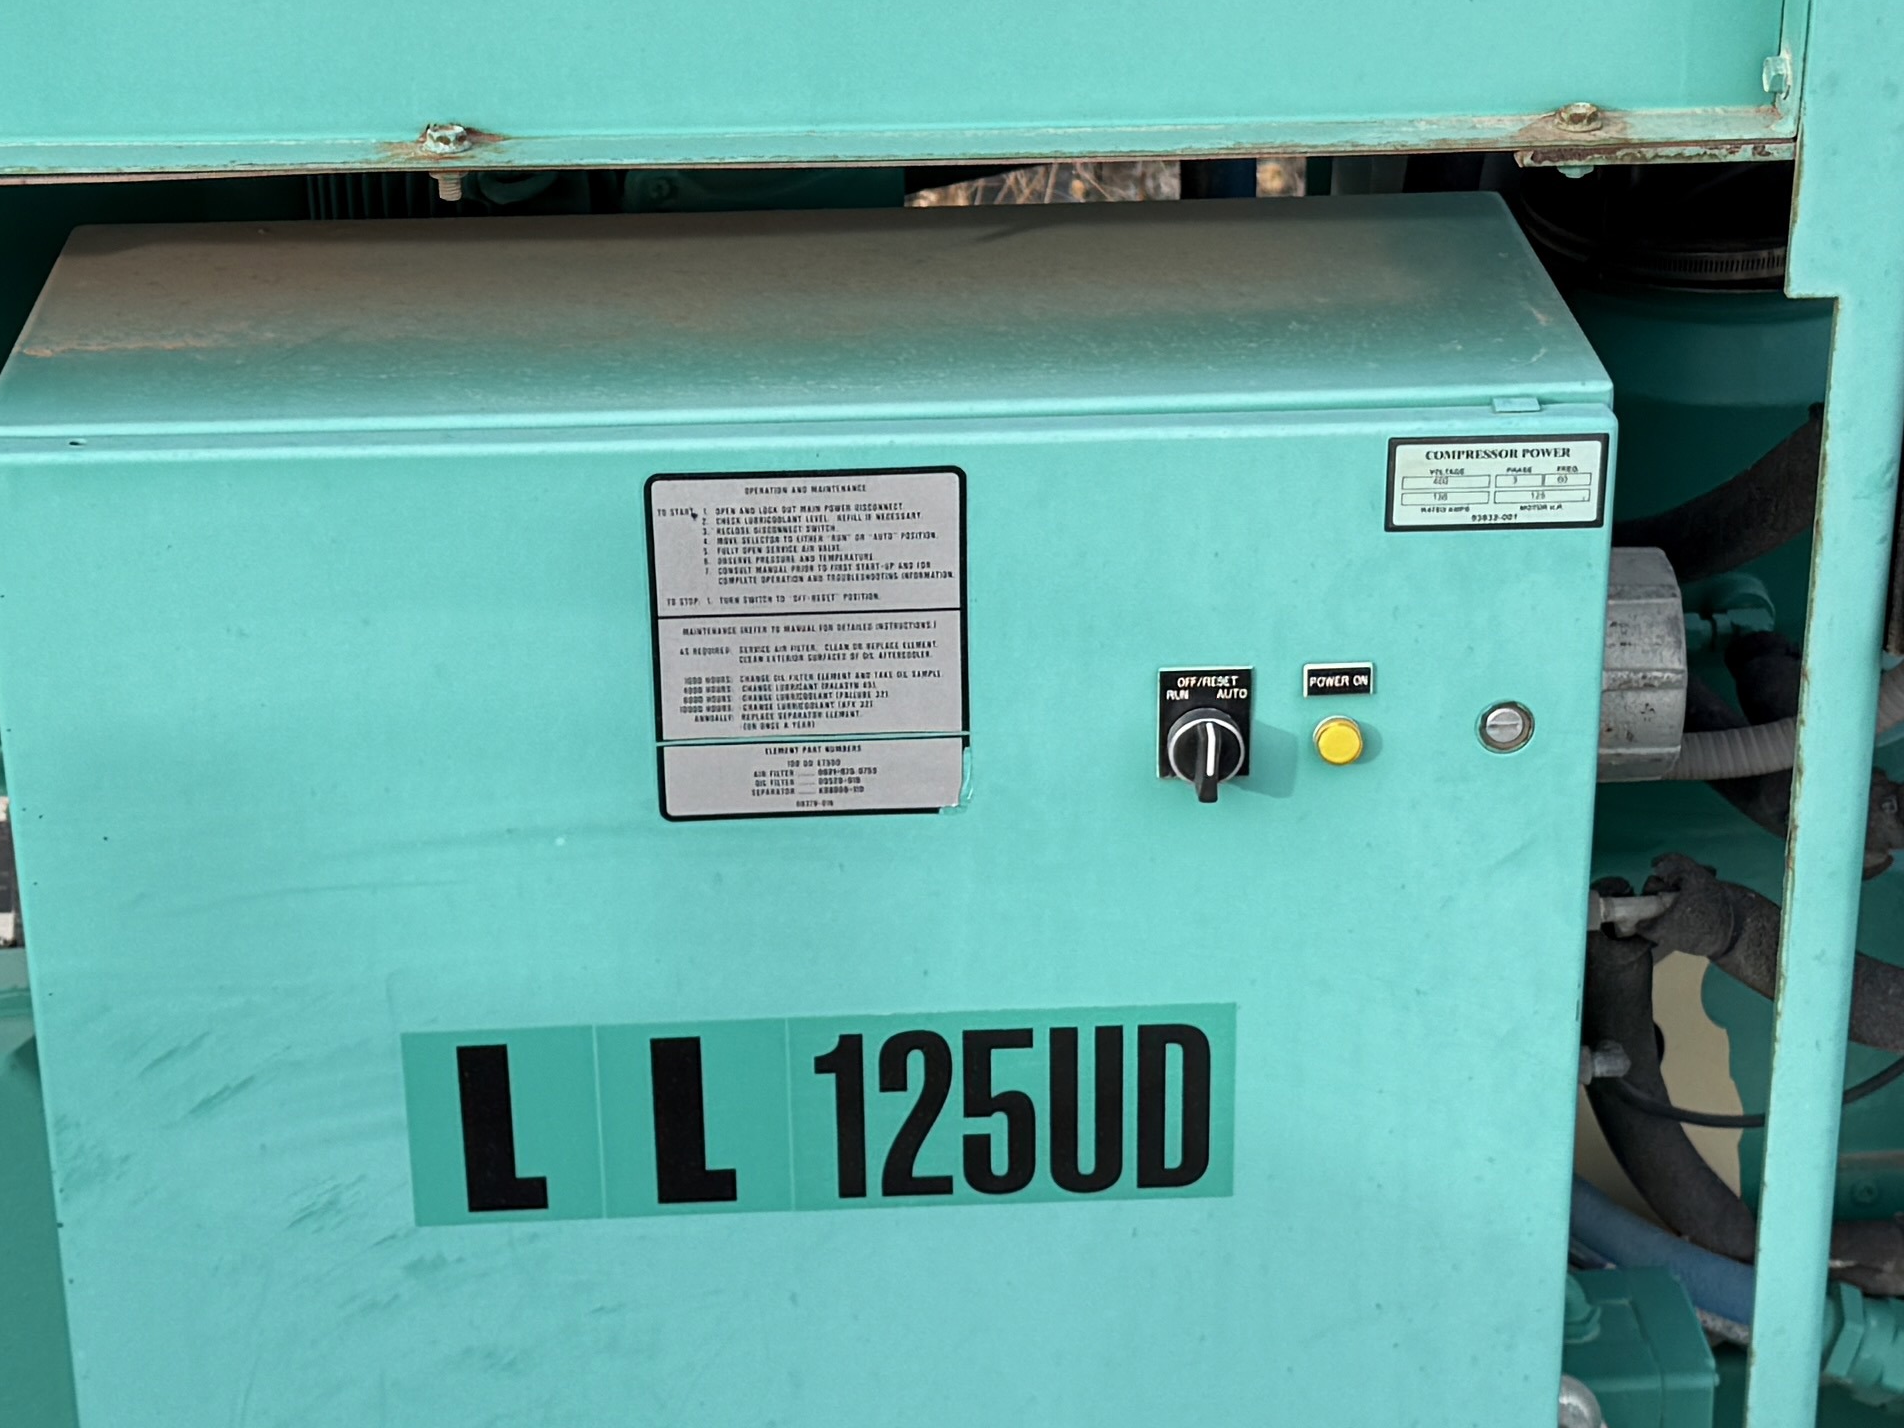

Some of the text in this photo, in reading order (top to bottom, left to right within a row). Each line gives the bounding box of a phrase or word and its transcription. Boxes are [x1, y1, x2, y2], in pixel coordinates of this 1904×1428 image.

[1426, 448, 1570, 461] COMPRESSOR POWER
[1177, 675, 1239, 688] OFF/RESET
[1310, 675, 1368, 688] POWER ON
[1166, 689, 1189, 700] RUN
[1216, 688, 1248, 700] AUTO
[455, 1022, 1212, 1213] L L 125UD
